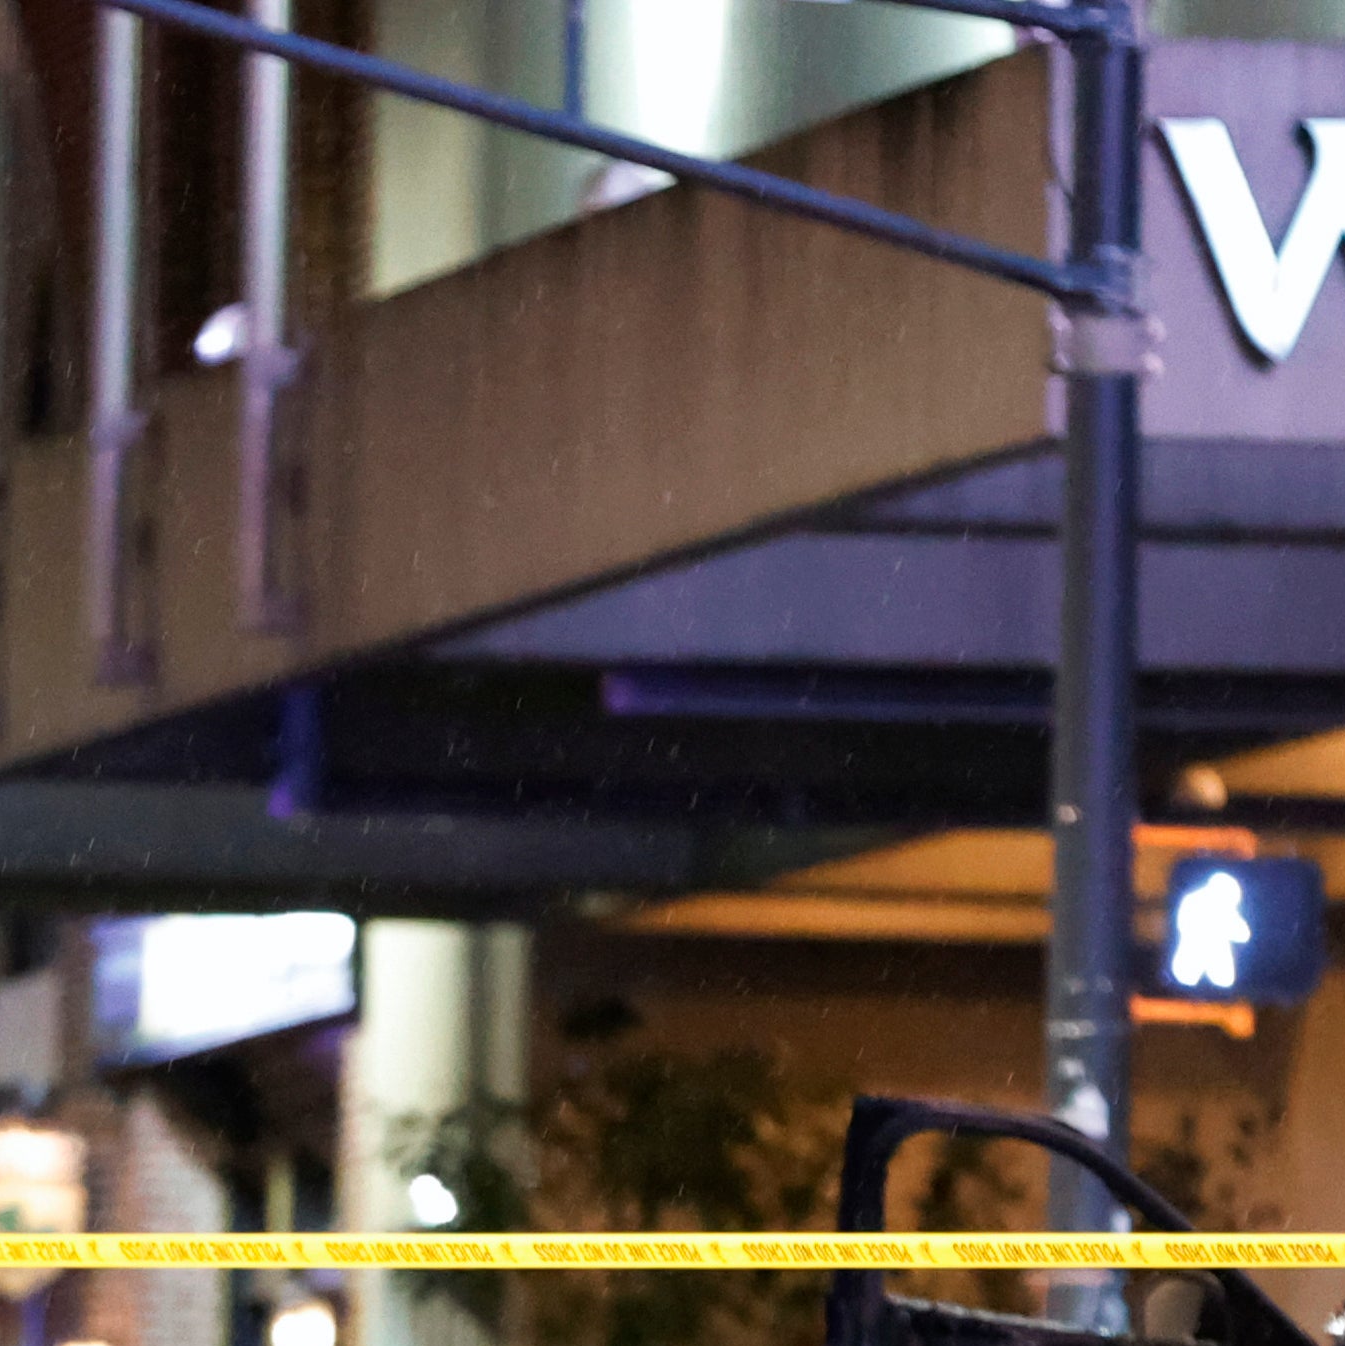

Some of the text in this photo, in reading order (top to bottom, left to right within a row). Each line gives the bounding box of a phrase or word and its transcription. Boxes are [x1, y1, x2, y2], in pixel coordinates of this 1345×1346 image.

[118, 1242, 162, 1262] CROSS
[163, 1242, 191, 1262] NOT
[209, 1242, 240, 1262] LINE
[239, 1242, 286, 1262] POLICE
[326, 1242, 370, 1262] CROSS
[370, 1242, 398, 1262] NOT
[416, 1242, 448, 1262] LINE
[447, 1242, 495, 1262] POLICE
[534, 1243, 578, 1262] CROSS
[578, 1243, 607, 1262] NOT
[625, 1243, 657, 1262] LINE
[656, 1243, 704, 1262] POLICE
[742, 1243, 787, 1263] CROSS
[787, 1243, 816, 1263] NOT
[834, 1243, 866, 1263] LINE
[865, 1243, 914, 1263] POLICE
[953, 1243, 998, 1262] CROSS
[998, 1243, 1027, 1262] NOT
[1046, 1243, 1078, 1262] LINE
[1077, 1243, 1126, 1262] POLICE
[1165, 1243, 1210, 1262] CROSS
[1210, 1243, 1239, 1262] NOT
[1258, 1243, 1290, 1262] LINE
[1289, 1243, 1338, 1262] POLICE
